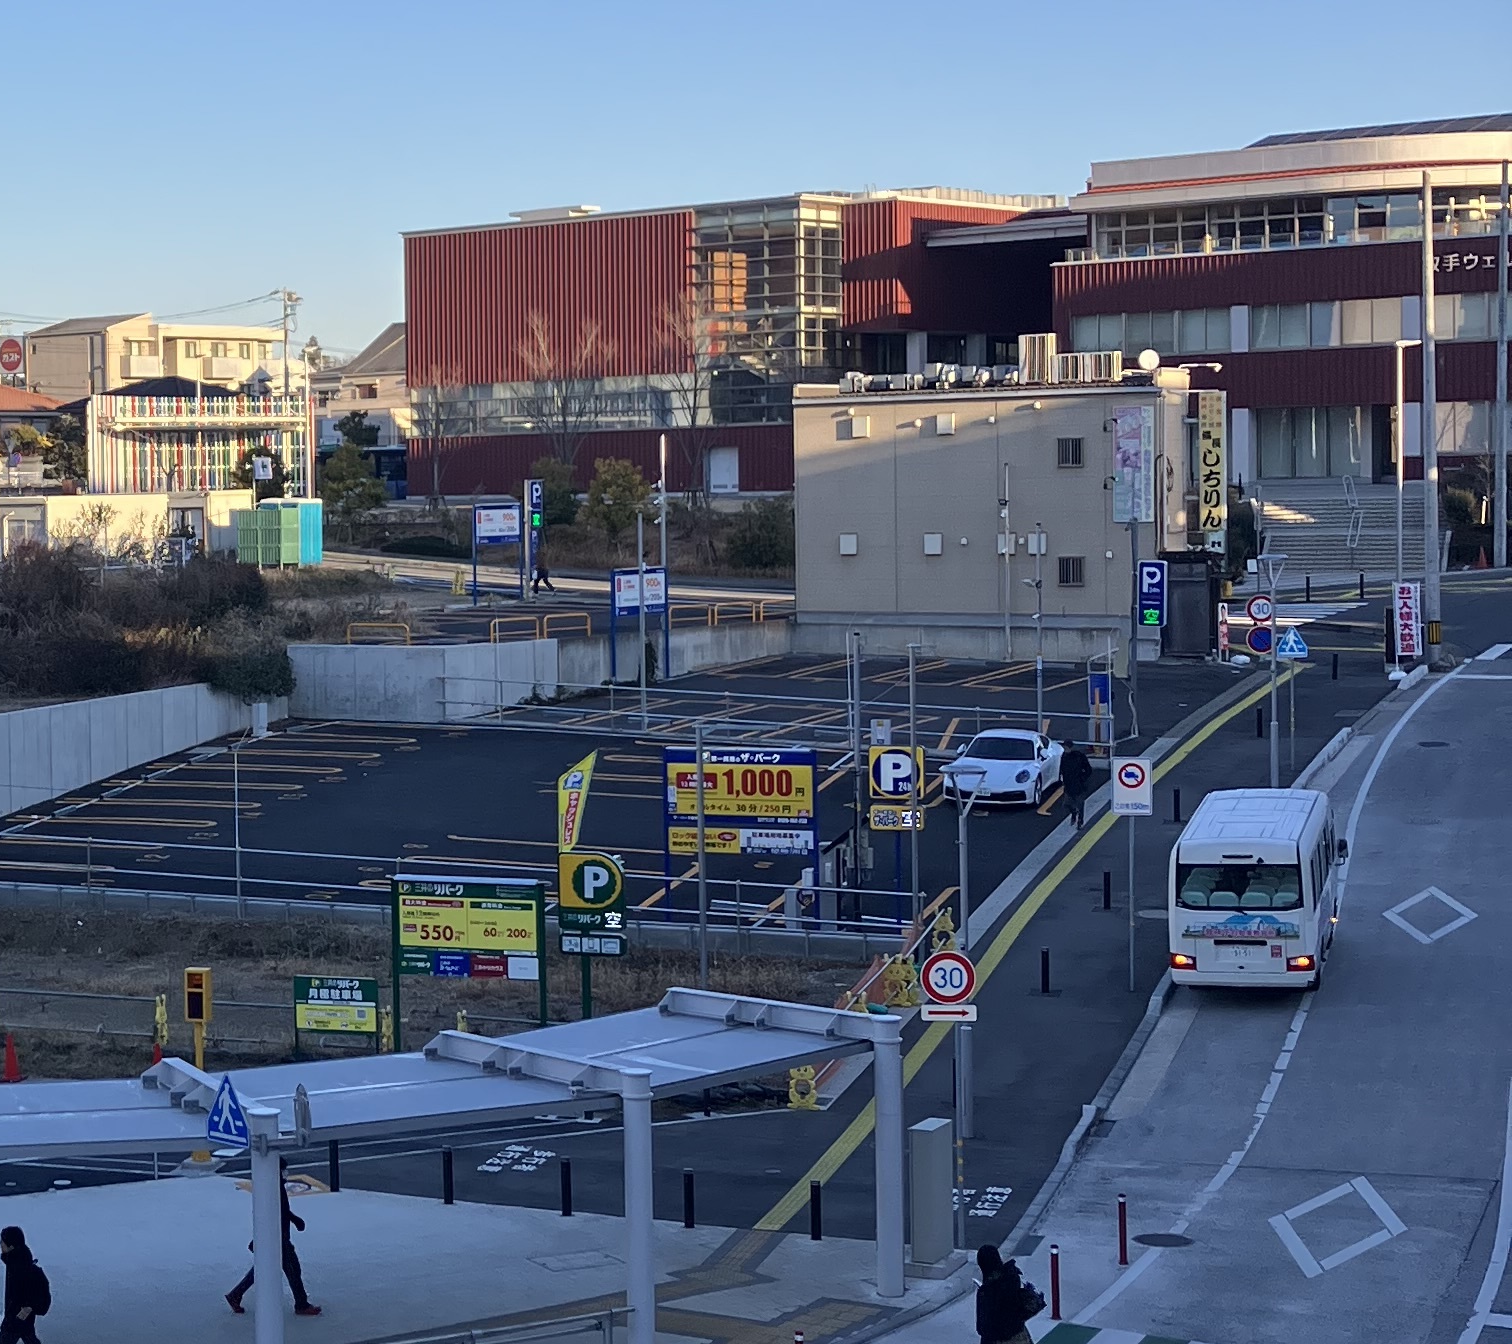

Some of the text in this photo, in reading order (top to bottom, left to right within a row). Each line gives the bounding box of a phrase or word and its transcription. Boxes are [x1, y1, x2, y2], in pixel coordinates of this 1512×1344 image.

[1433, 253, 1512, 272] 手ウェ
[2, 353, 20, 364] ガスト
[1202, 449, 1222, 529] しちりん
[1142, 566, 1161, 593] P
[1143, 609, 1160, 624] 空
[1253, 602, 1270, 615] 30
[880, 753, 912, 792] P
[584, 865, 610, 899] P
[604, 911, 622, 929] 空
[419, 924, 455, 942] 550
[934, 967, 963, 989] 30
